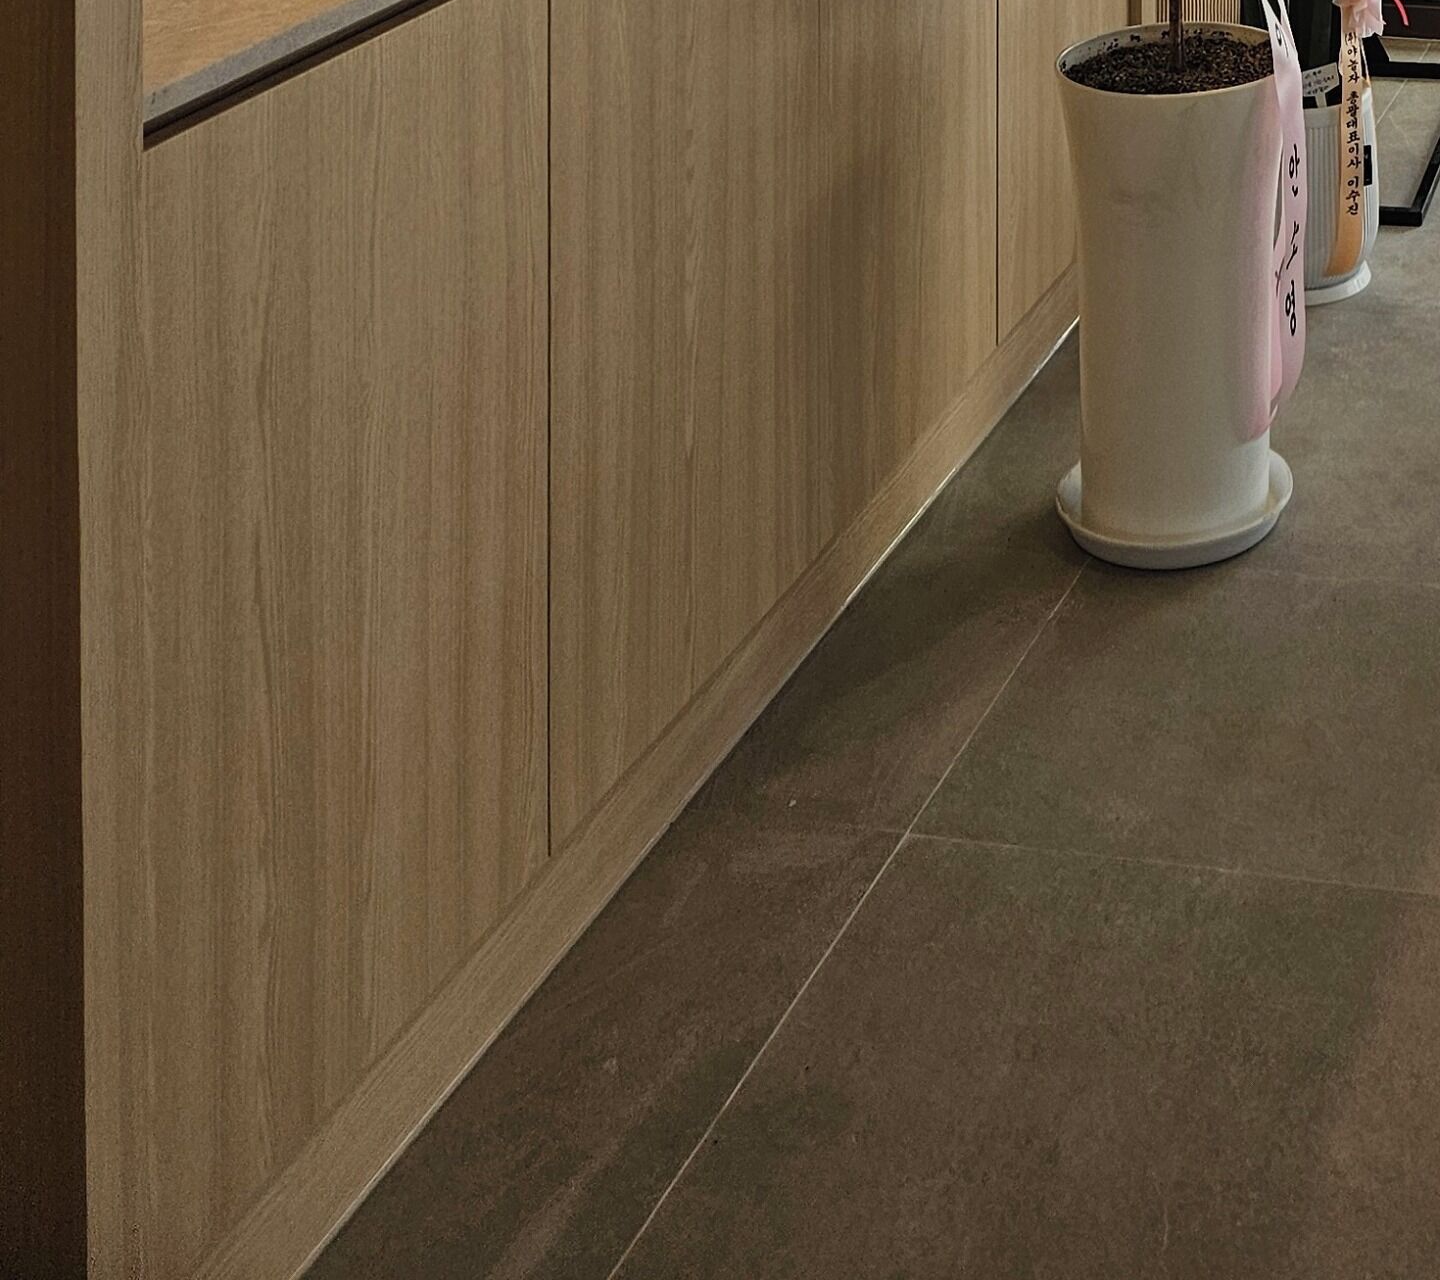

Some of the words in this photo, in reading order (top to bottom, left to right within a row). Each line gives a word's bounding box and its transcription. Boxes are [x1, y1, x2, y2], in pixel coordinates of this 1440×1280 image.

[1344, 31, 1360, 85] (주)야놀자
[1346, 90, 1362, 171] 총괄대표이사
[1346, 175, 1361, 217] 이수진
